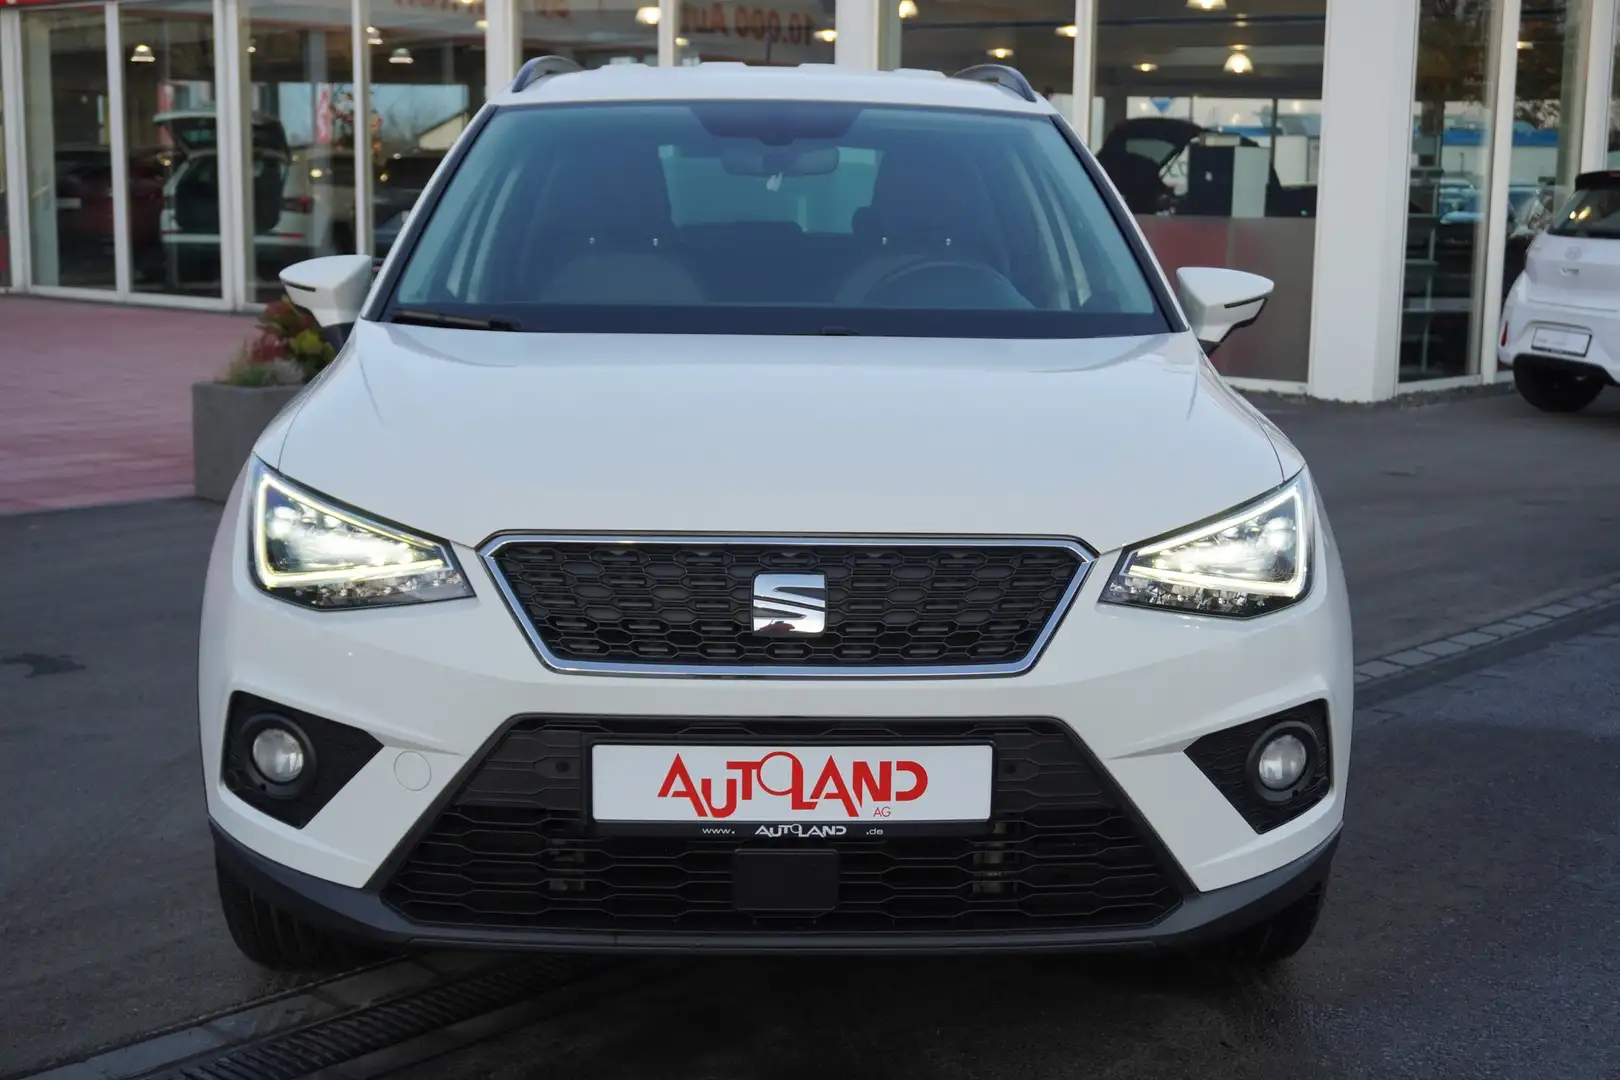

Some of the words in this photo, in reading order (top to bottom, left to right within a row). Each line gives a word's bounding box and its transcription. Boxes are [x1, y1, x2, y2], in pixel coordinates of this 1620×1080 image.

[657, 751, 929, 818] AUTOLAND
[873, 806, 891, 817] AG
[702, 827, 736, 835] www.
[866, 827, 884, 835] .de
